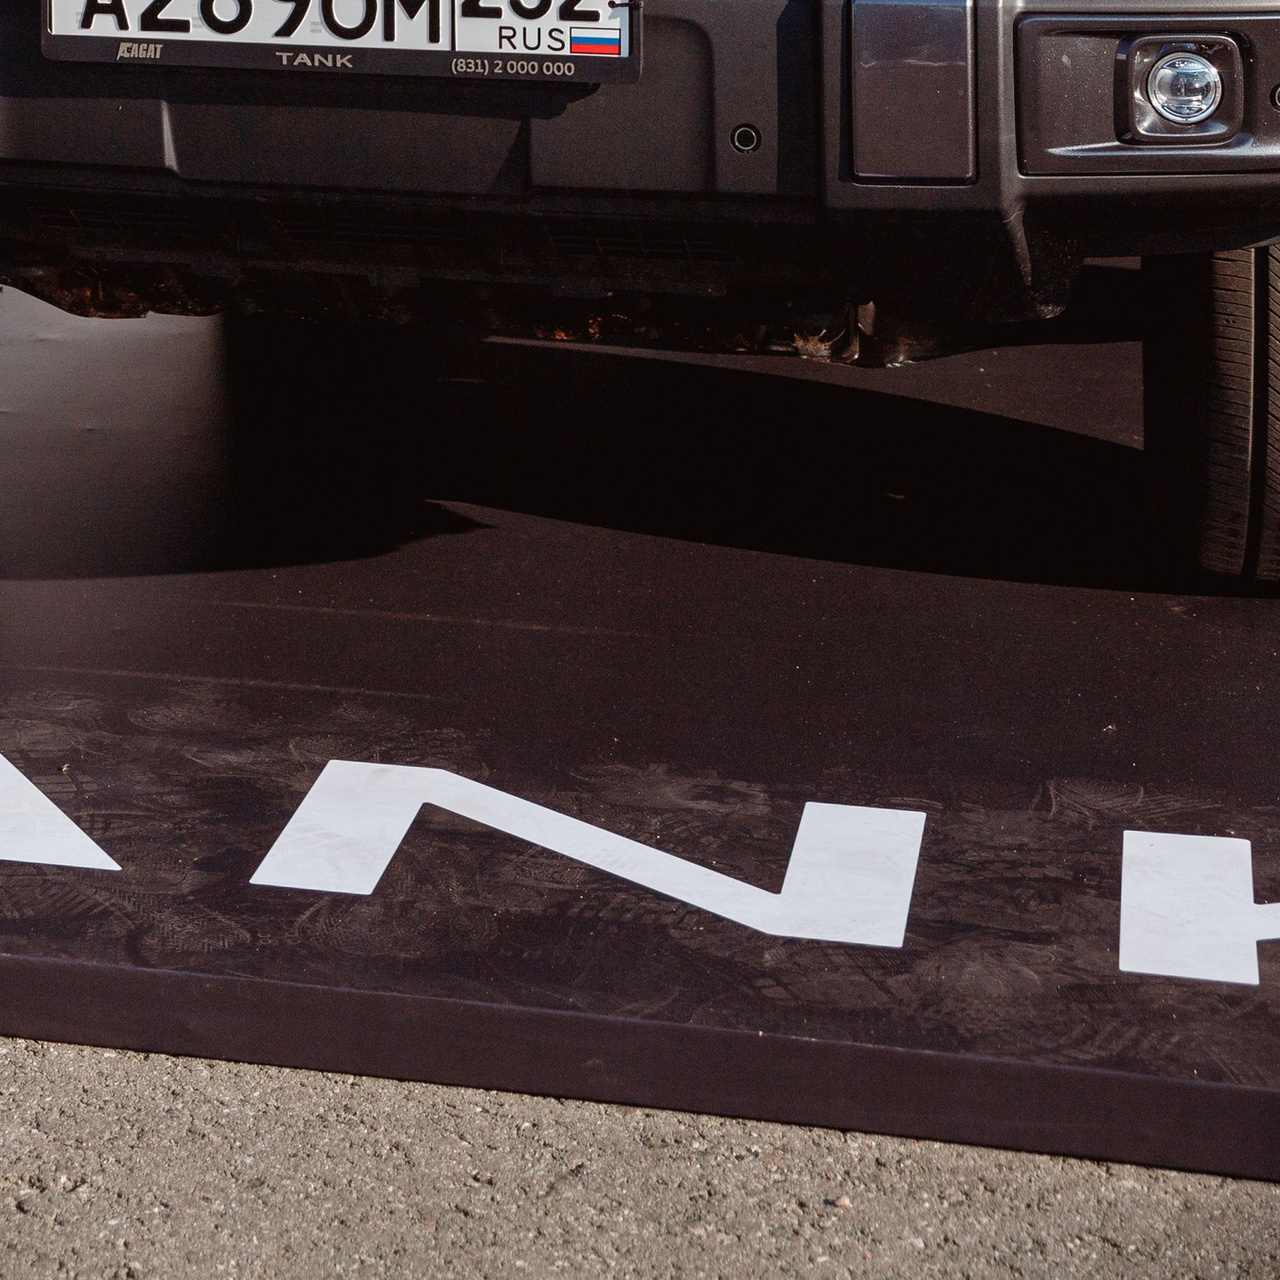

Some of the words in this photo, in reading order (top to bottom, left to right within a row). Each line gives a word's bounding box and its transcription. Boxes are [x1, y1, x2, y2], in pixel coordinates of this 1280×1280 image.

[498, 25, 566, 52] RUS
[275, 51, 354, 68] TANK
[451, 58, 489, 76] (831)
[493, 60, 503, 74] 2
[506, 60, 539, 75] 000
[542, 61, 575, 76] 000
